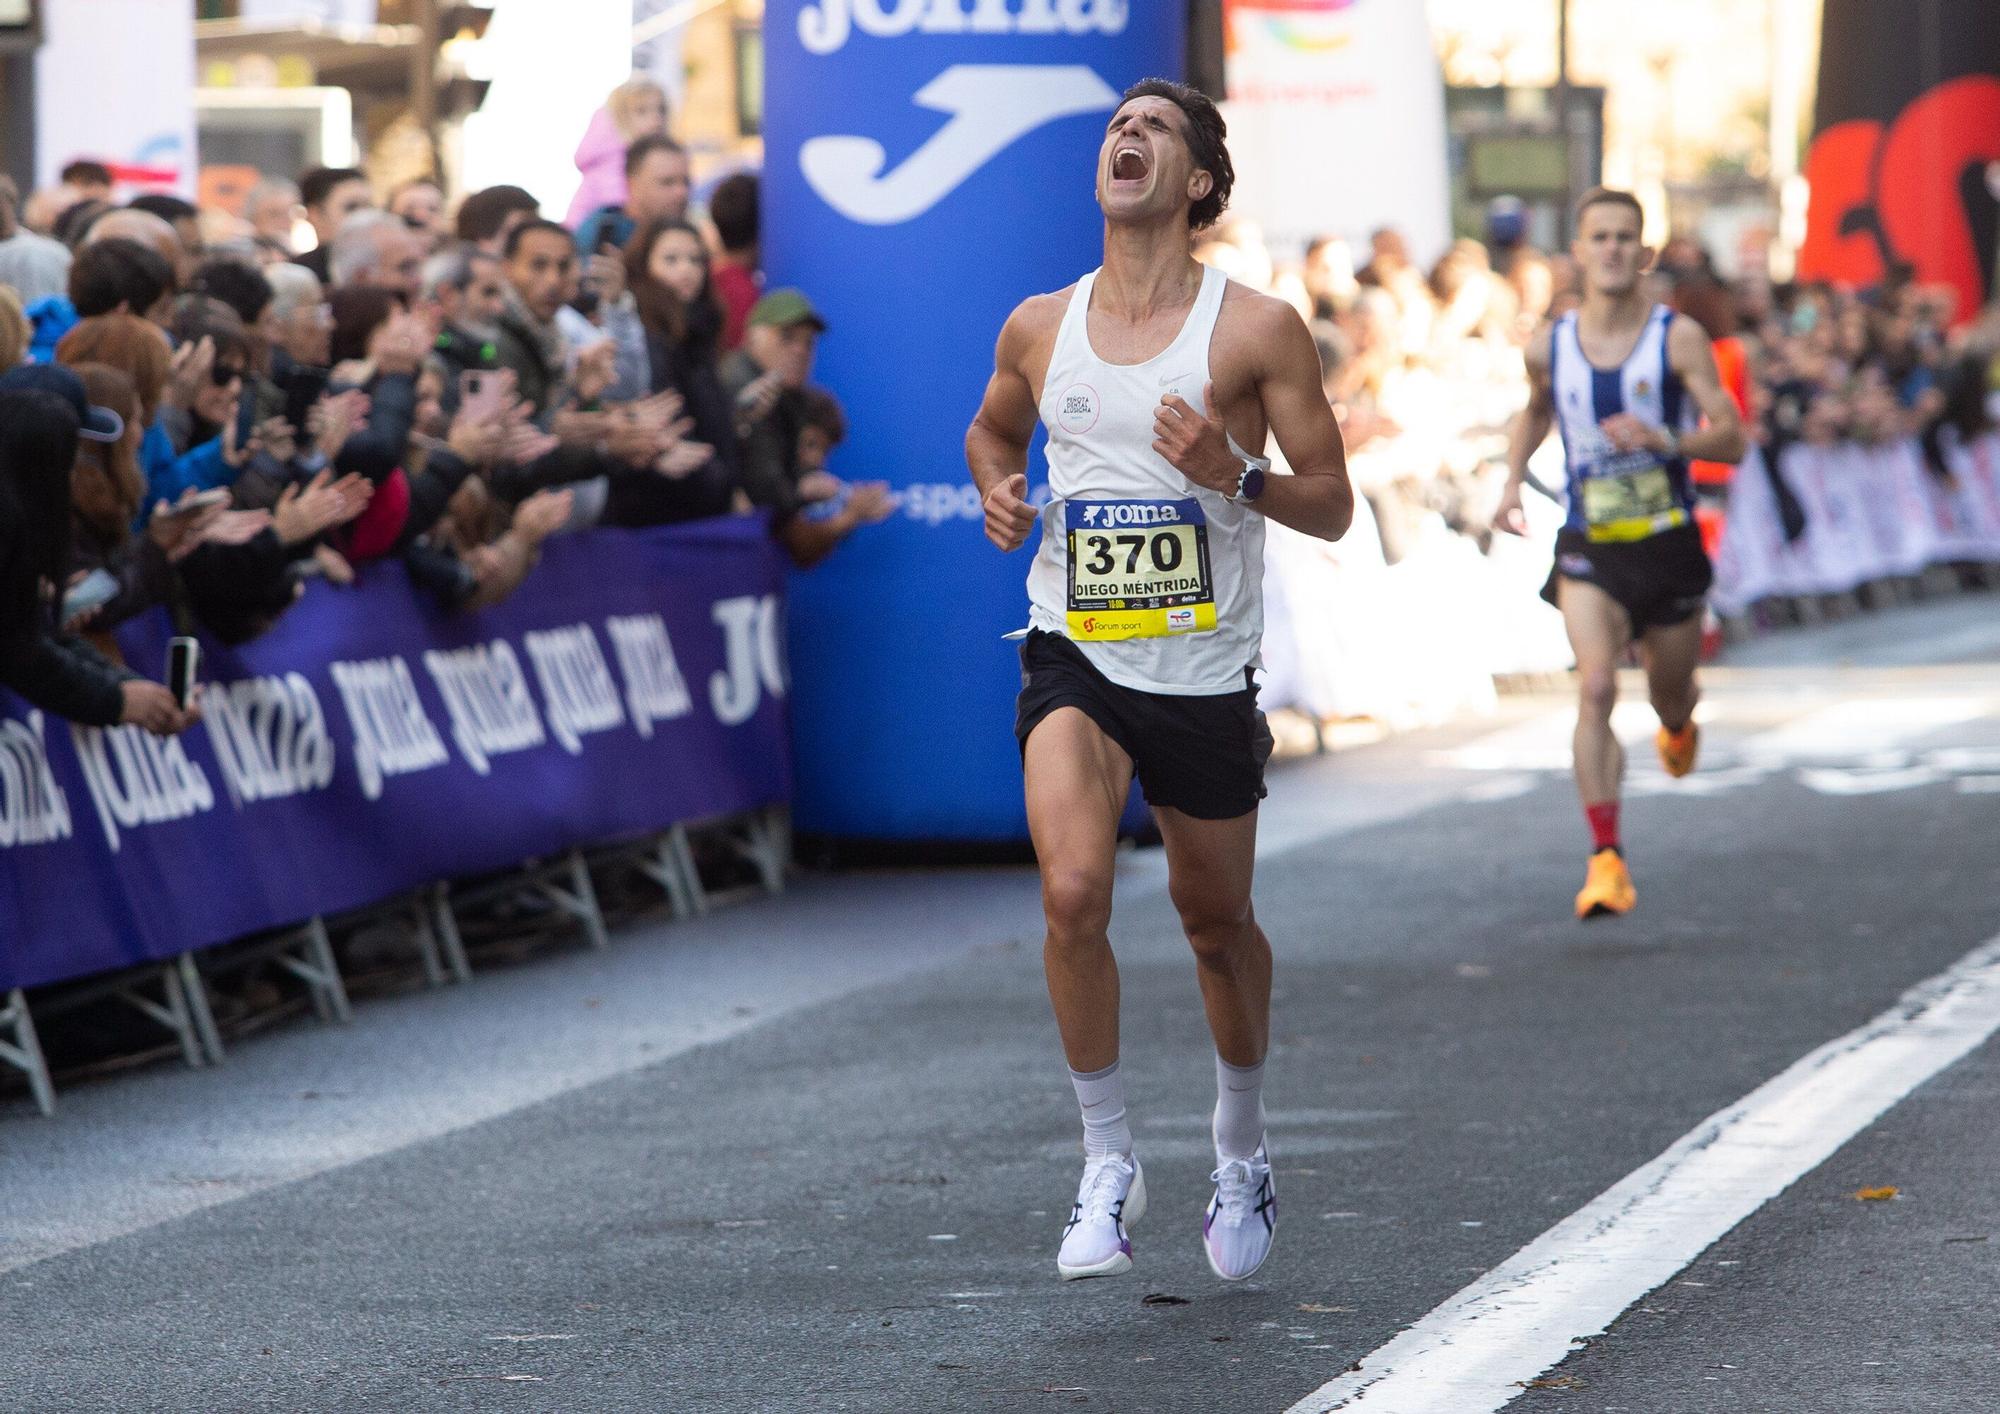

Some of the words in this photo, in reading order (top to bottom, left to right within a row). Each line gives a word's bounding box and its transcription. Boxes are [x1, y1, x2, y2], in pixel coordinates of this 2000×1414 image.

[1067, 395, 1089, 403] PEÑOTA
[1085, 532, 1183, 576] 370
[1076, 583, 1119, 597] DIEGO
[1123, 577, 1200, 596] MÉNTRIDA
[1120, 621, 1142, 632] sport
